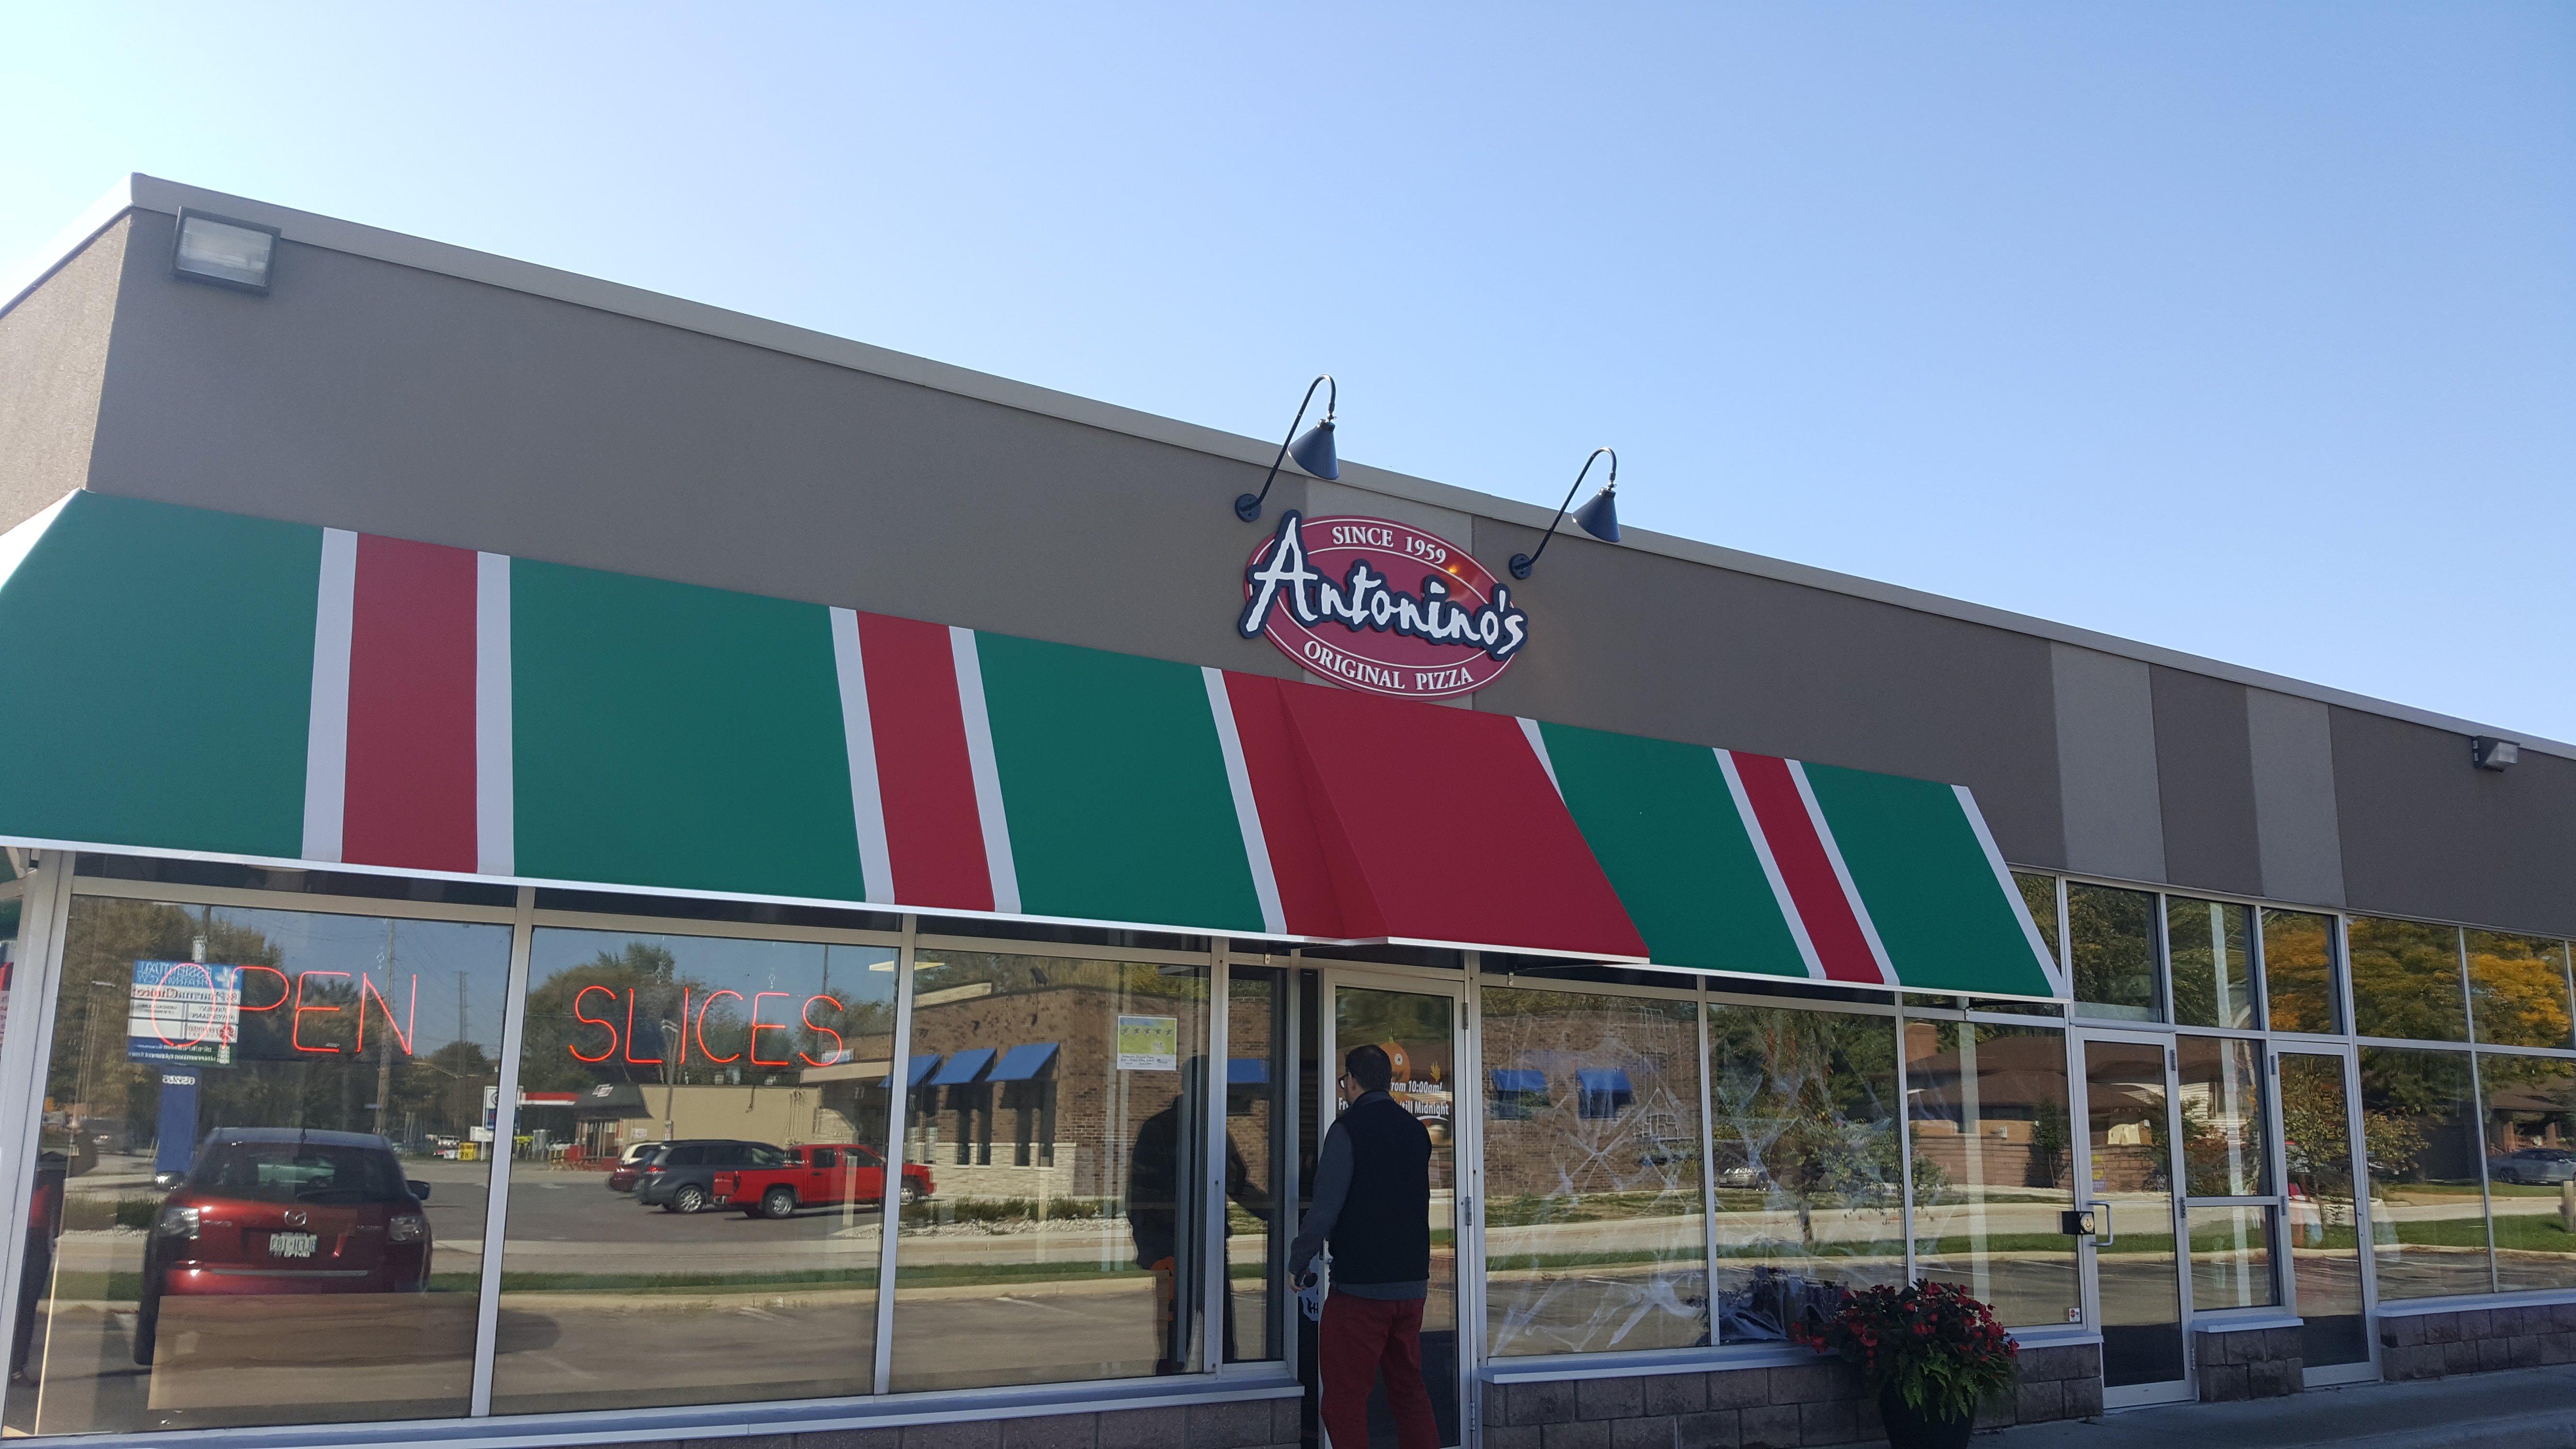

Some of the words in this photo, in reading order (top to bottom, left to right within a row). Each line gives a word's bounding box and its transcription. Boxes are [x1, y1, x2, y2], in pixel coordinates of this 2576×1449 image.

[1332, 526, 1394, 548] SINCE
[1405, 536, 1447, 564] 1959
[1245, 516, 1524, 655] Antonino's
[1304, 640, 1405, 690] ORIGINAL
[1416, 666, 1474, 691] PIZZA
[151, 962, 417, 1056] OPEN
[568, 985, 843, 1067] SLICES
[1408, 1080, 1443, 1093] 10:00am!
[1415, 1100, 1449, 1117] Midnight
